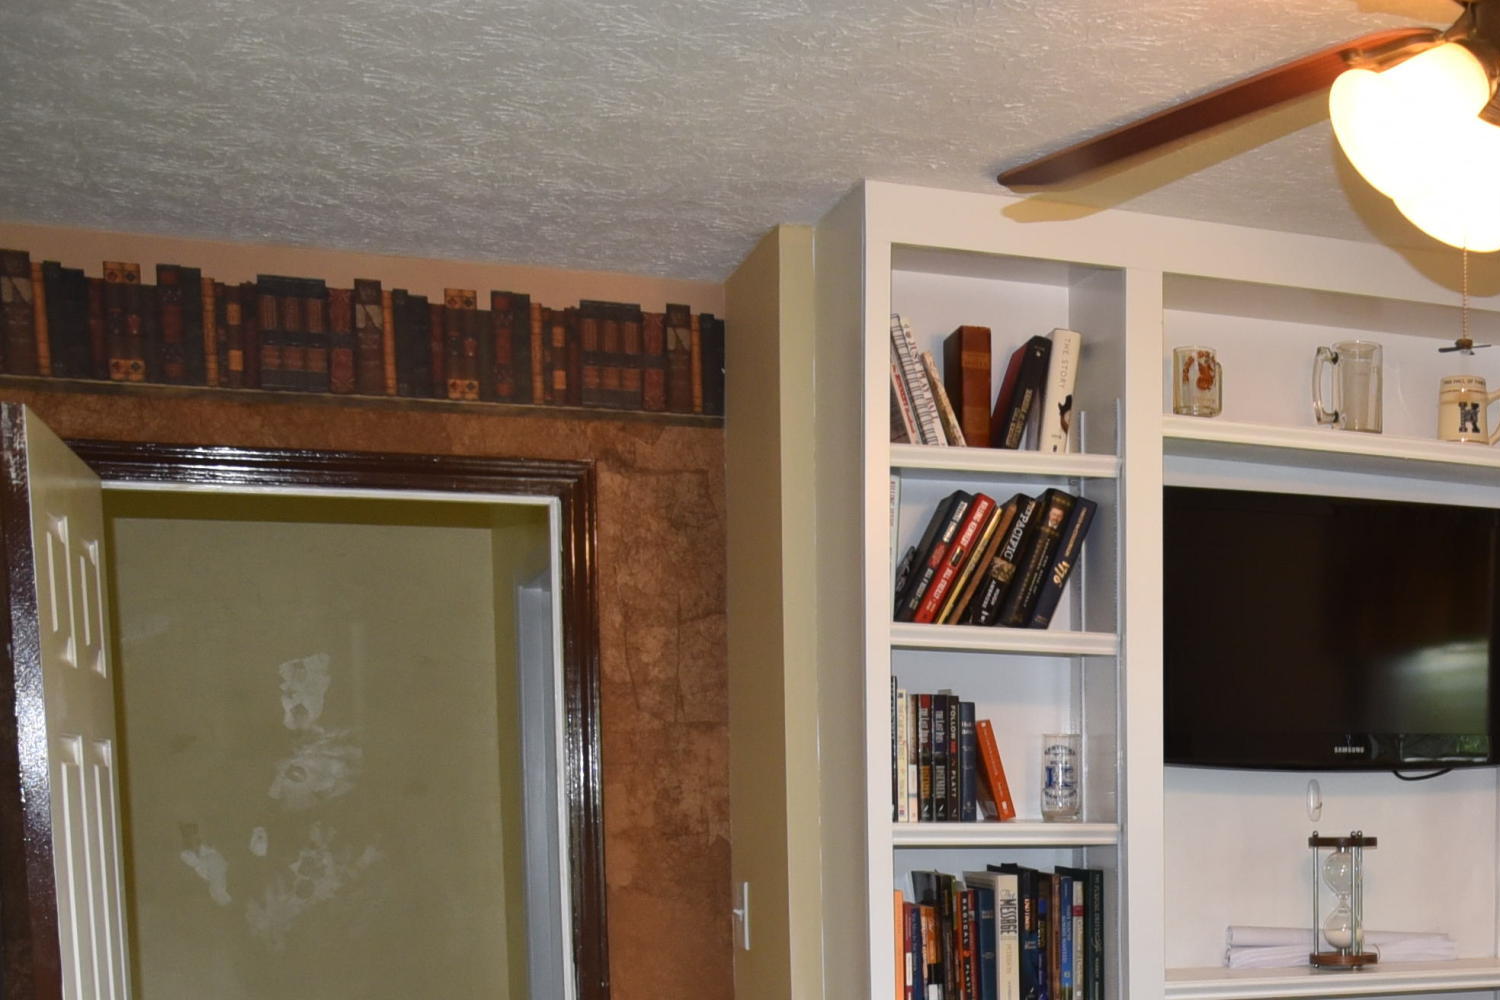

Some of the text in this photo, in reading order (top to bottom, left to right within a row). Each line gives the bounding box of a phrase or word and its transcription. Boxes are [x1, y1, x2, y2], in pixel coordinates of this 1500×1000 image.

[1059, 339, 1071, 390] THE STORY
[1002, 513, 1030, 560] PACIFIC
[1000, 899, 1017, 934] MESSAGE
